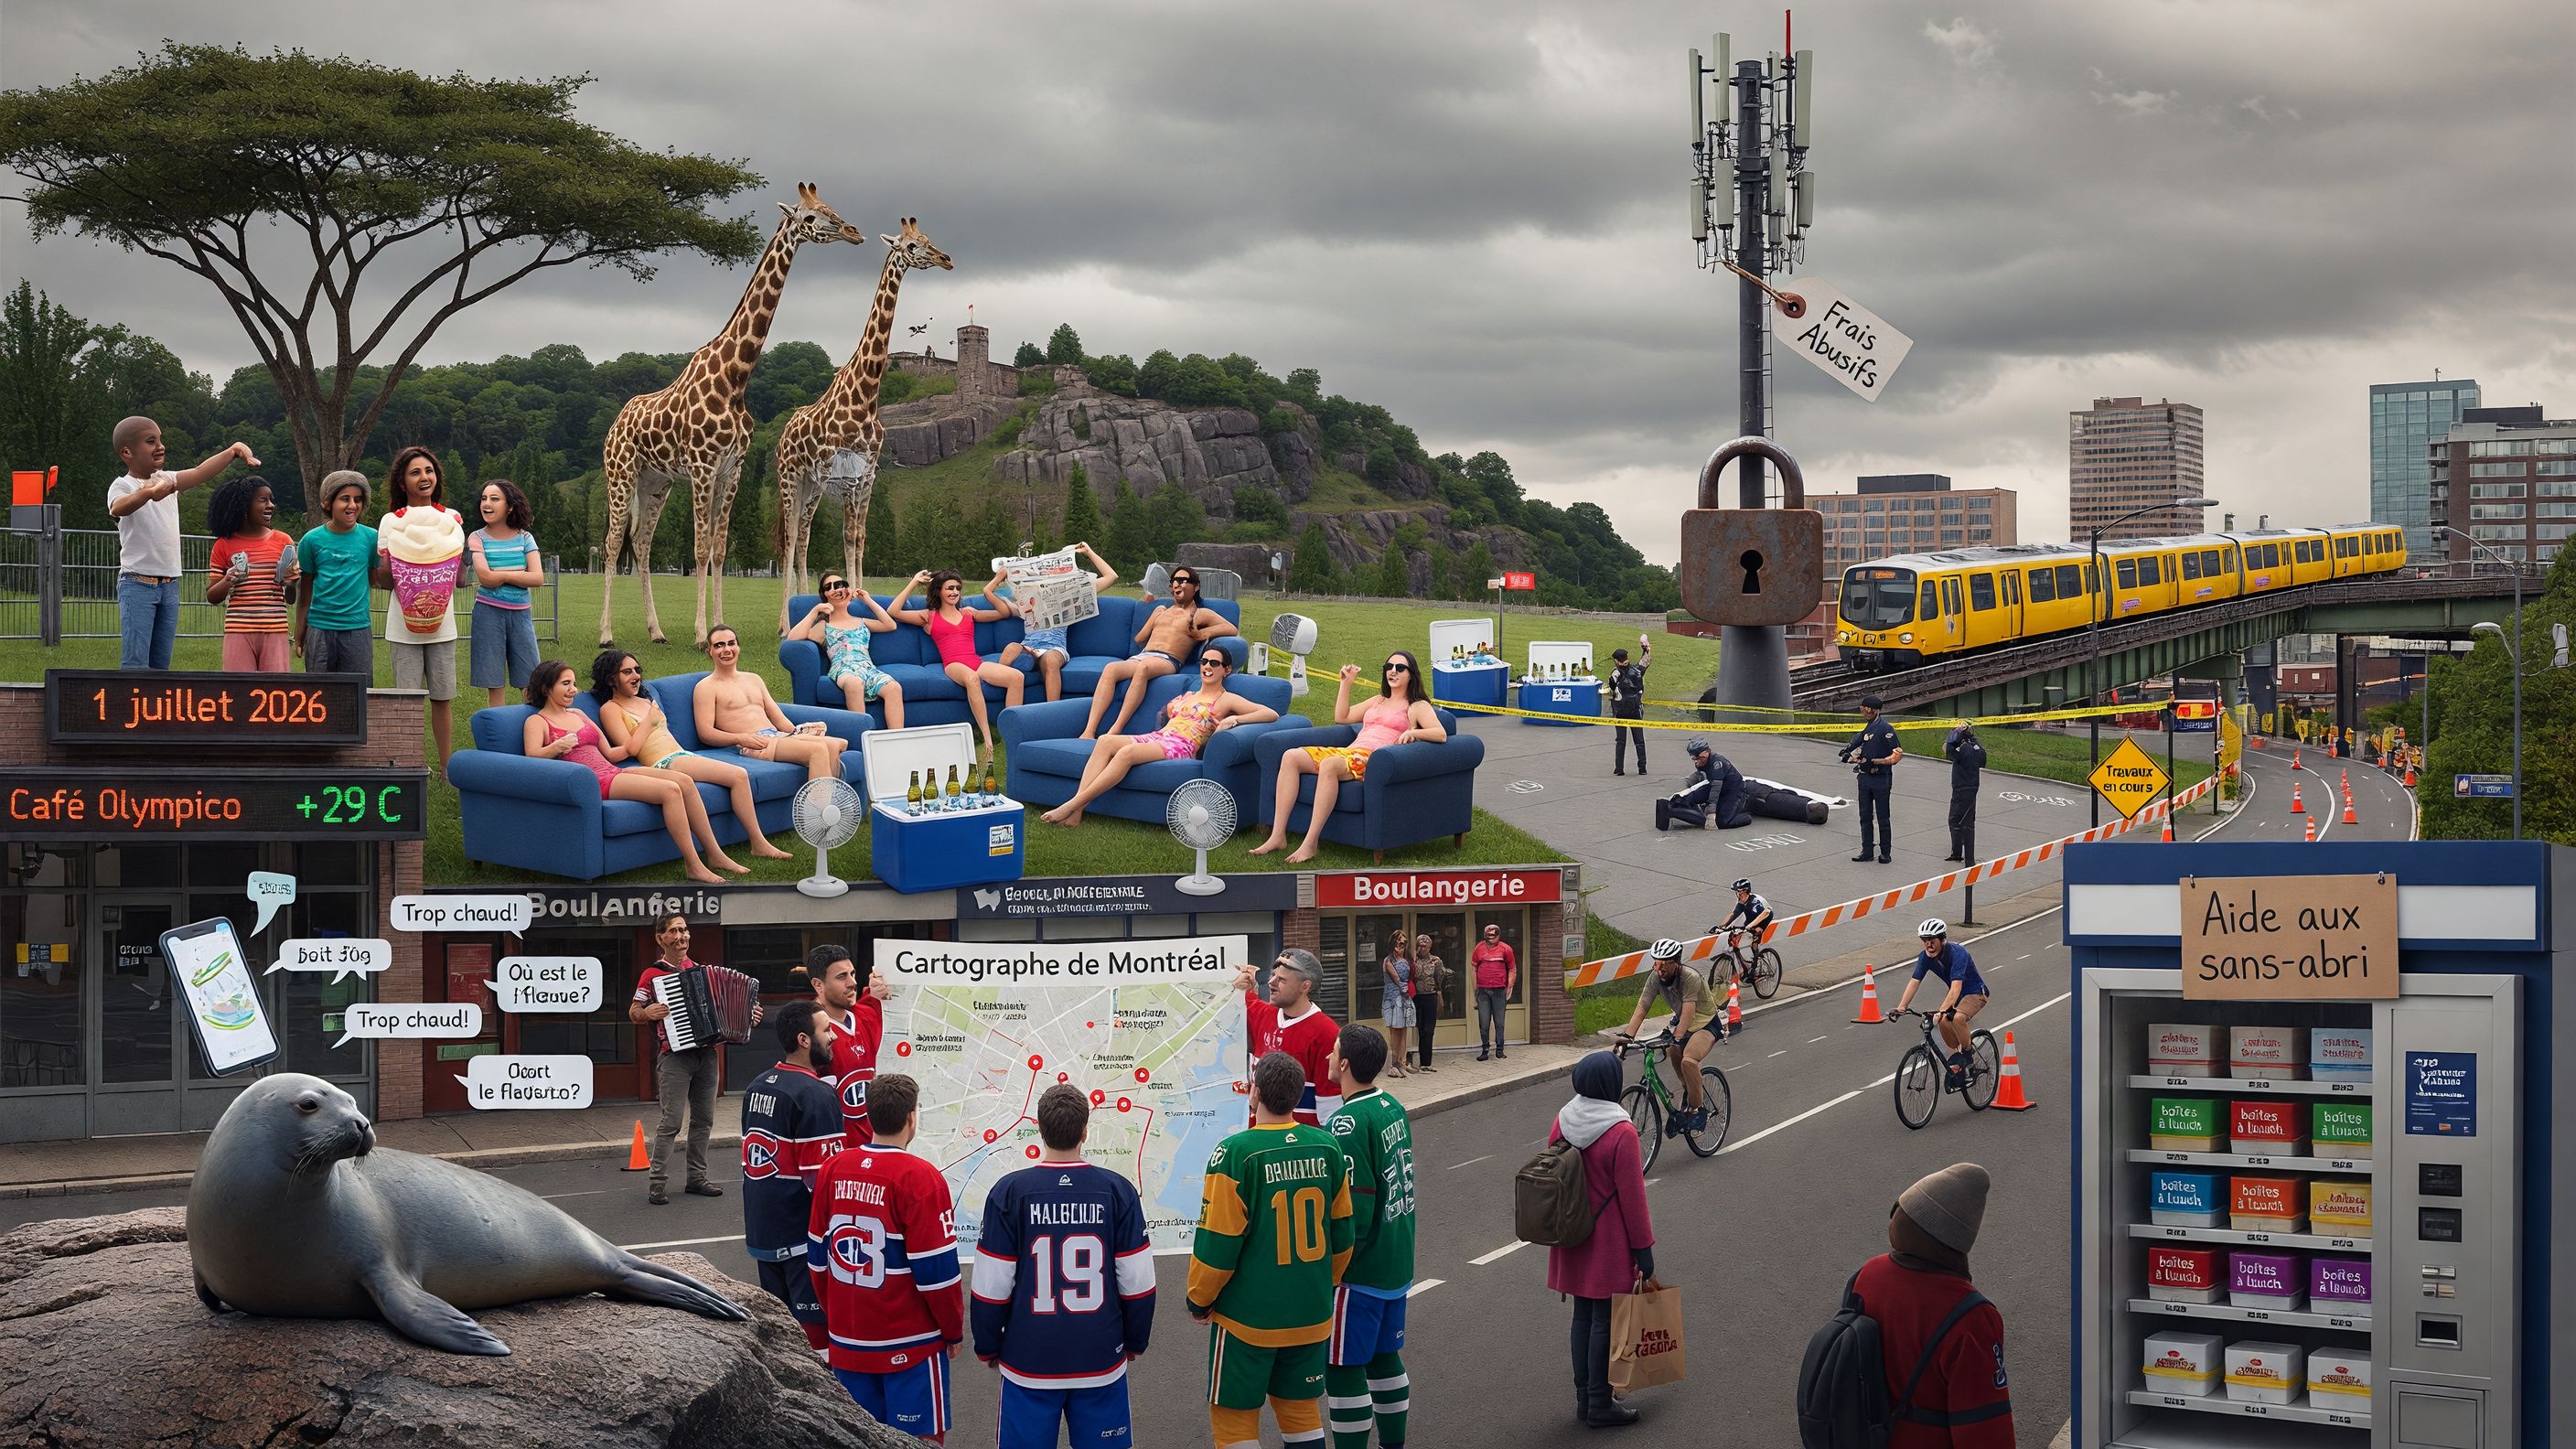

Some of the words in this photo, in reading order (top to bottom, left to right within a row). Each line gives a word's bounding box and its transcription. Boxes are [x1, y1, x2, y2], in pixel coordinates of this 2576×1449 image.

[1823, 300, 1877, 350] Frais
[1798, 323, 1877, 388] Abusifs
[92, 688, 106, 721] 1
[124, 687, 233, 729] juillet
[248, 689, 327, 724] 2026
[2106, 765, 2153, 778] Travaux
[2119, 782, 2153, 793] cours
[10, 789, 84, 821] Café
[99, 789, 242, 829] Olympico
[1354, 874, 1526, 904] Boulangerie
[402, 903, 447, 927] Trop
[454, 903, 519, 923] chaud!
[2202, 889, 2281, 936] Aide
[2298, 906, 2360, 931] aux
[509, 963, 533, 982] Où
[540, 965, 566, 982] est
[573, 963, 587, 981] le
[896, 950, 1061, 982] Cartographe
[1068, 951, 1100, 976] de
[1109, 947, 1226, 975] Montréal
[2199, 939, 2368, 982] sans-abri
[357, 1011, 400, 1034] Trop
[406, 1010, 469, 1029] chaud!
[479, 1083, 495, 1100] le
[1271, 1186, 1327, 1266] 10
[1030, 1233, 1106, 1315] 19
